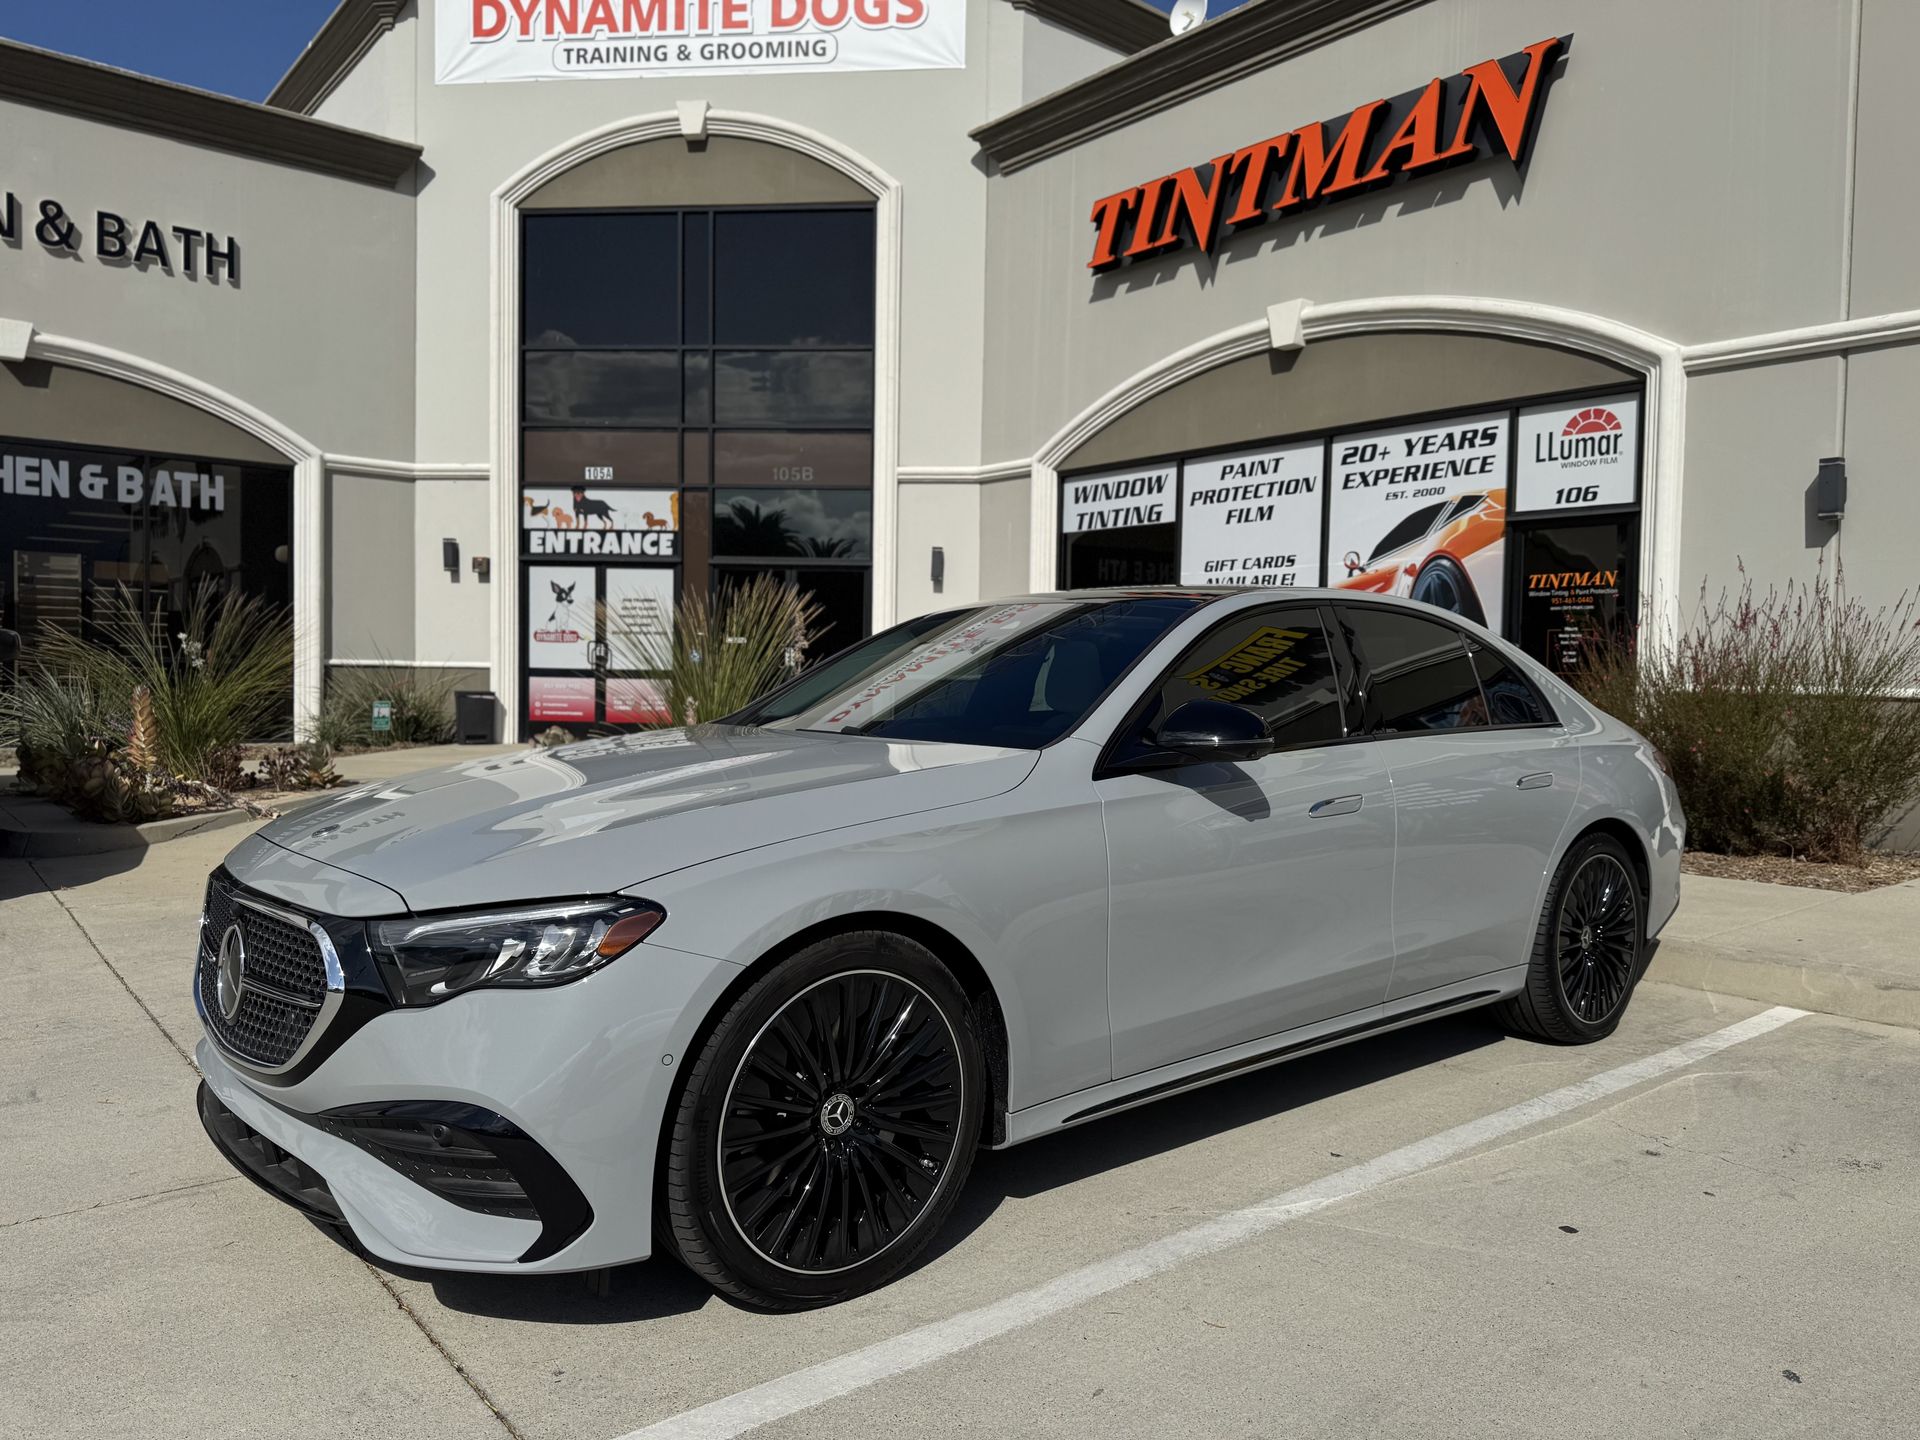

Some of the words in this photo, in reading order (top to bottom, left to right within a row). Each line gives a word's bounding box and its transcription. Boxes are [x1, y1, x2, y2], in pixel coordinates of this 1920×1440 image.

[472, 0, 749, 38] DYNAMITE
[770, 0, 925, 27] DOGS
[563, 44, 668, 65] TRAINING
[676, 43, 692, 62] &
[700, 39, 827, 60] GROOMING
[1087, 36, 1564, 270] TINTMAN
[35, 198, 76, 251] &
[97, 210, 235, 280] BATH
[1340, 444, 1391, 466] 20+
[1404, 426, 1499, 457] YEARS
[1535, 432, 1623, 463] LLumar
[585, 466, 613, 480] 105A
[773, 467, 813, 481] 105B
[1220, 457, 1284, 480] PAINT
[1342, 455, 1496, 490] EXPERIENCE
[1560, 458, 1598, 469] WINDOW
[1599, 457, 1618, 465] FILM
[79, 464, 109, 499] &
[117, 465, 225, 511] BATH
[1074, 474, 1169, 505] WINDOW
[1190, 476, 1317, 506] PROTECTION
[1385, 490, 1408, 501] EST.
[1412, 486, 1446, 498] 2000
[1555, 484, 1600, 504] 106
[1076, 504, 1163, 531] TINTING
[1225, 504, 1275, 525] FILM
[529, 530, 674, 556] ENTRANCE
[1204, 559, 1238, 572] GIFT
[1242, 555, 1296, 570] CARDS
[1529, 570, 1618, 589] TINTMAN
